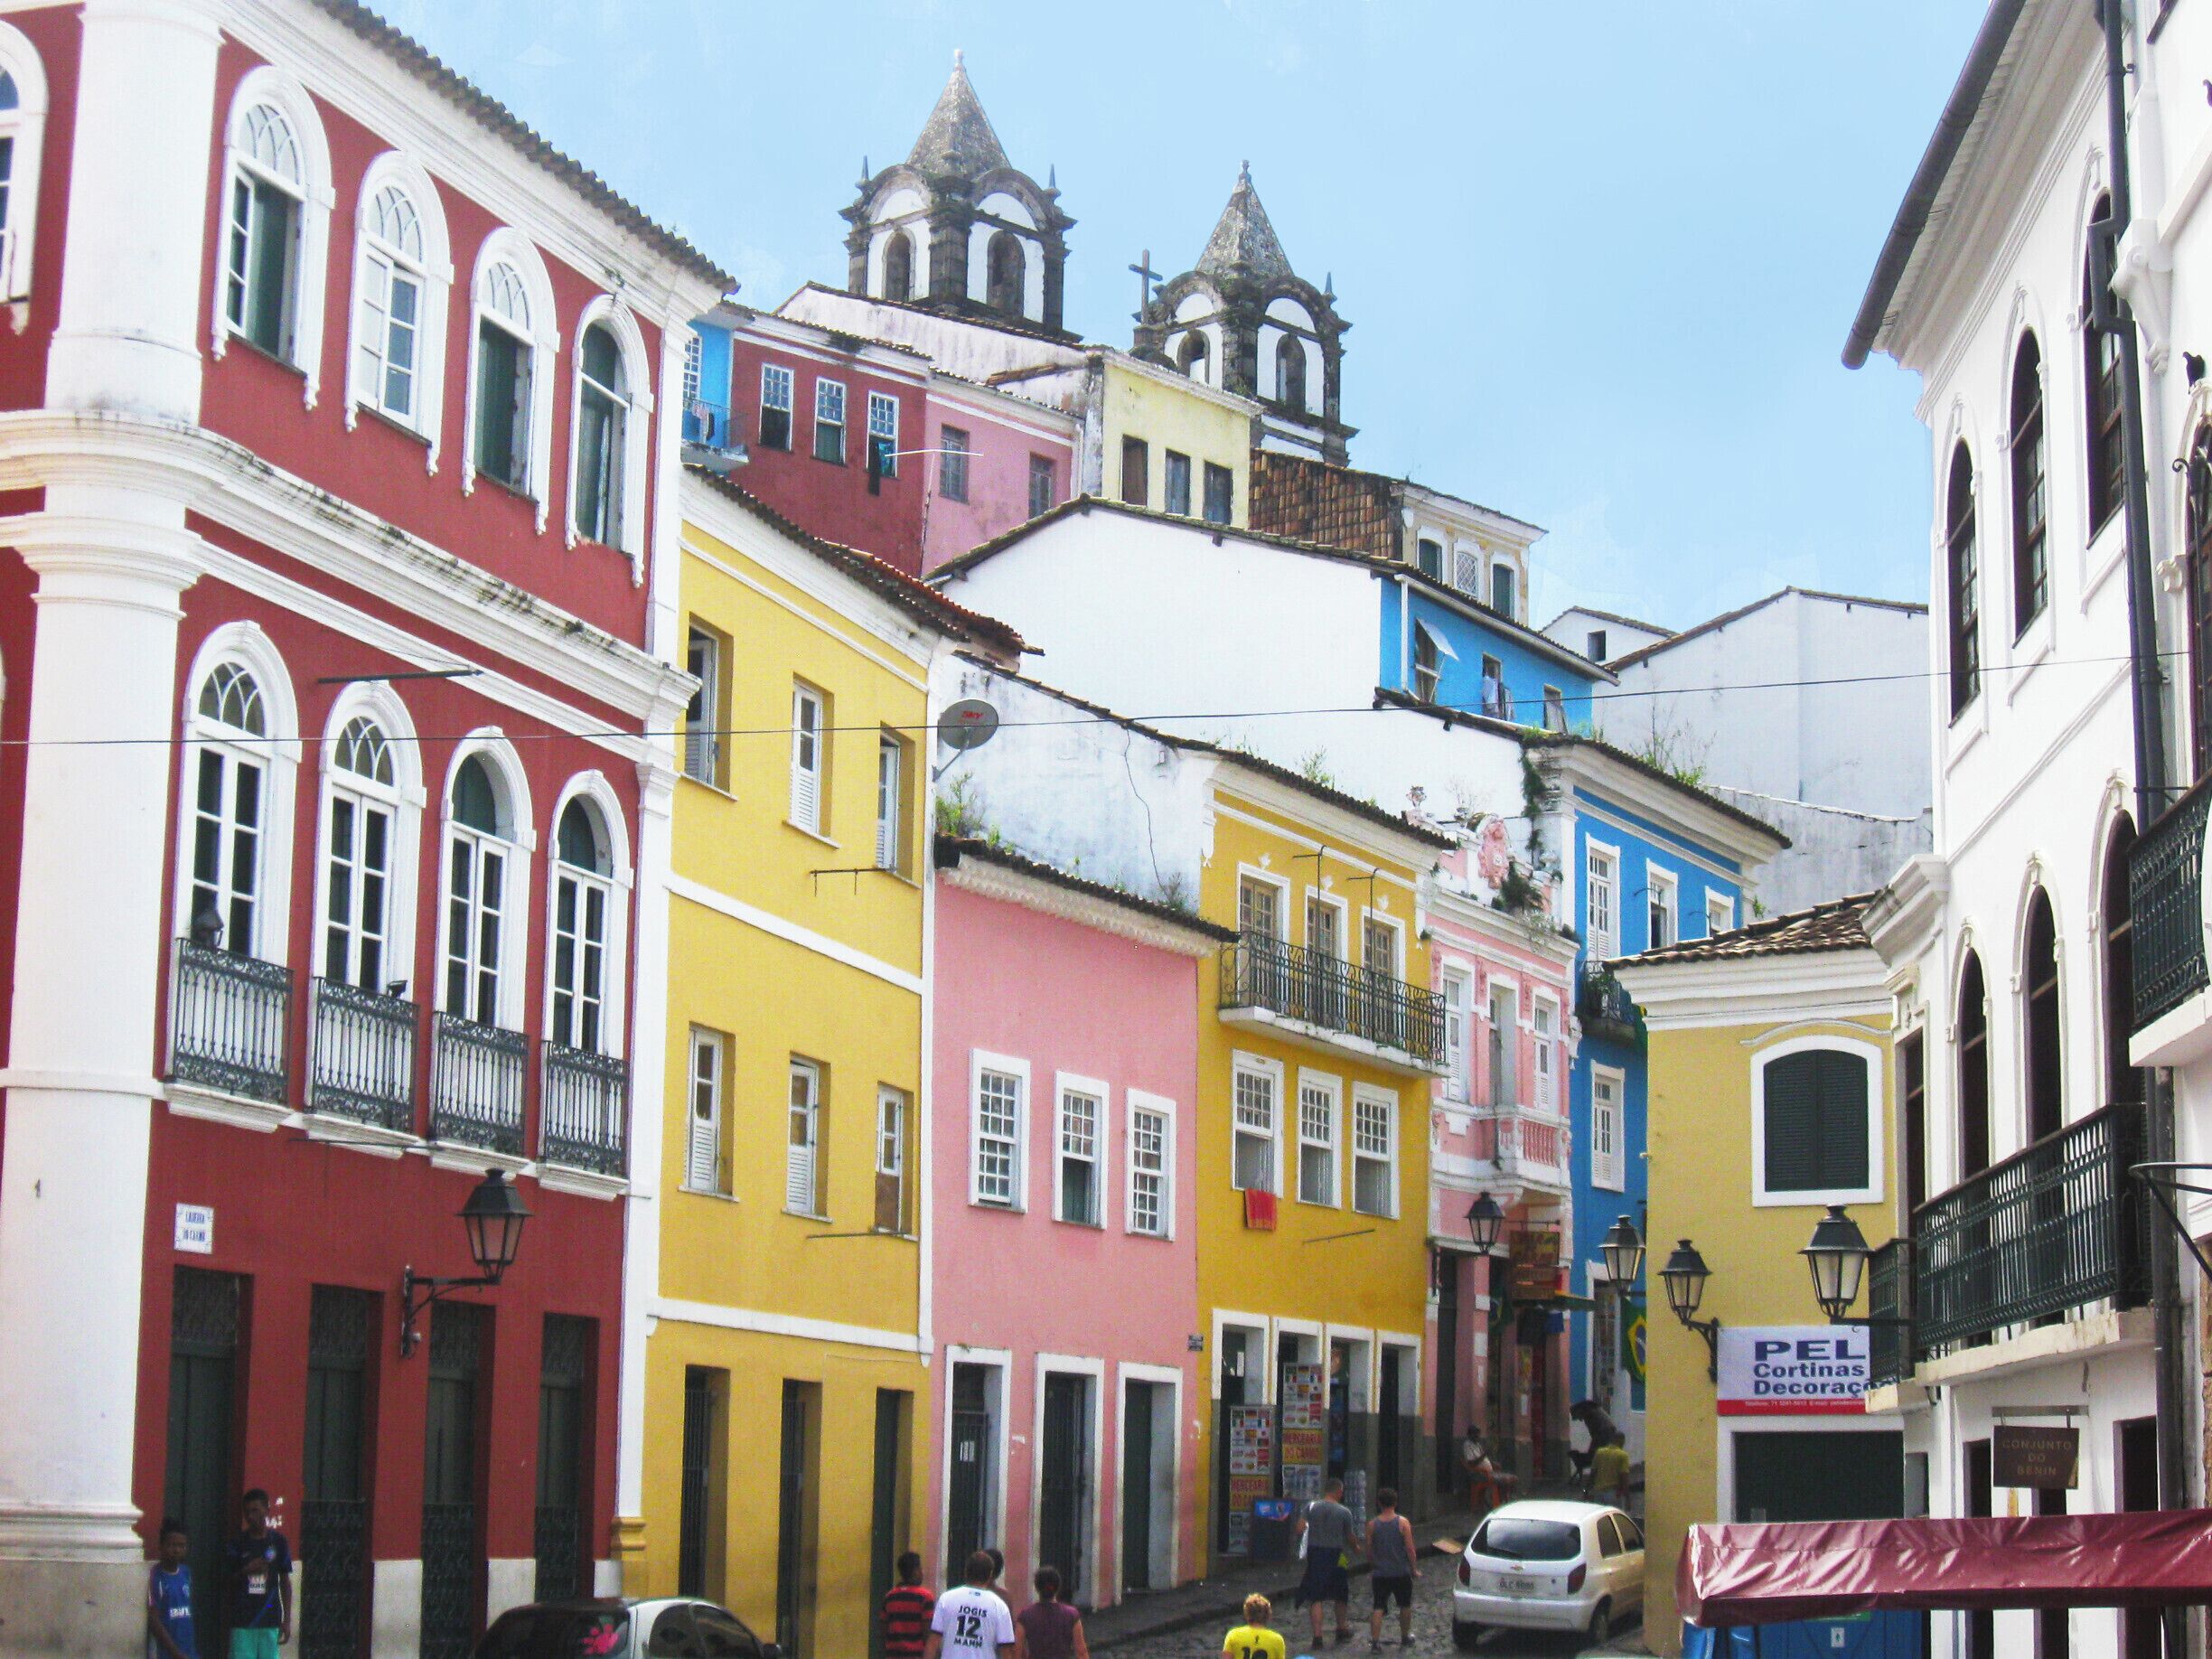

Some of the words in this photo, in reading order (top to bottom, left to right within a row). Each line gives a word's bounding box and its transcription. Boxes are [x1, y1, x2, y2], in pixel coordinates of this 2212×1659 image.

[1754, 1339, 1867, 1362] PEL
[1753, 1362, 1865, 1378] Cortinas
[2002, 1439, 2072, 1451] CONJUNTO
[2028, 1452, 2046, 1463] DO
[959, 1606, 987, 1617] JOGIS
[954, 1637, 982, 1647] MANN
